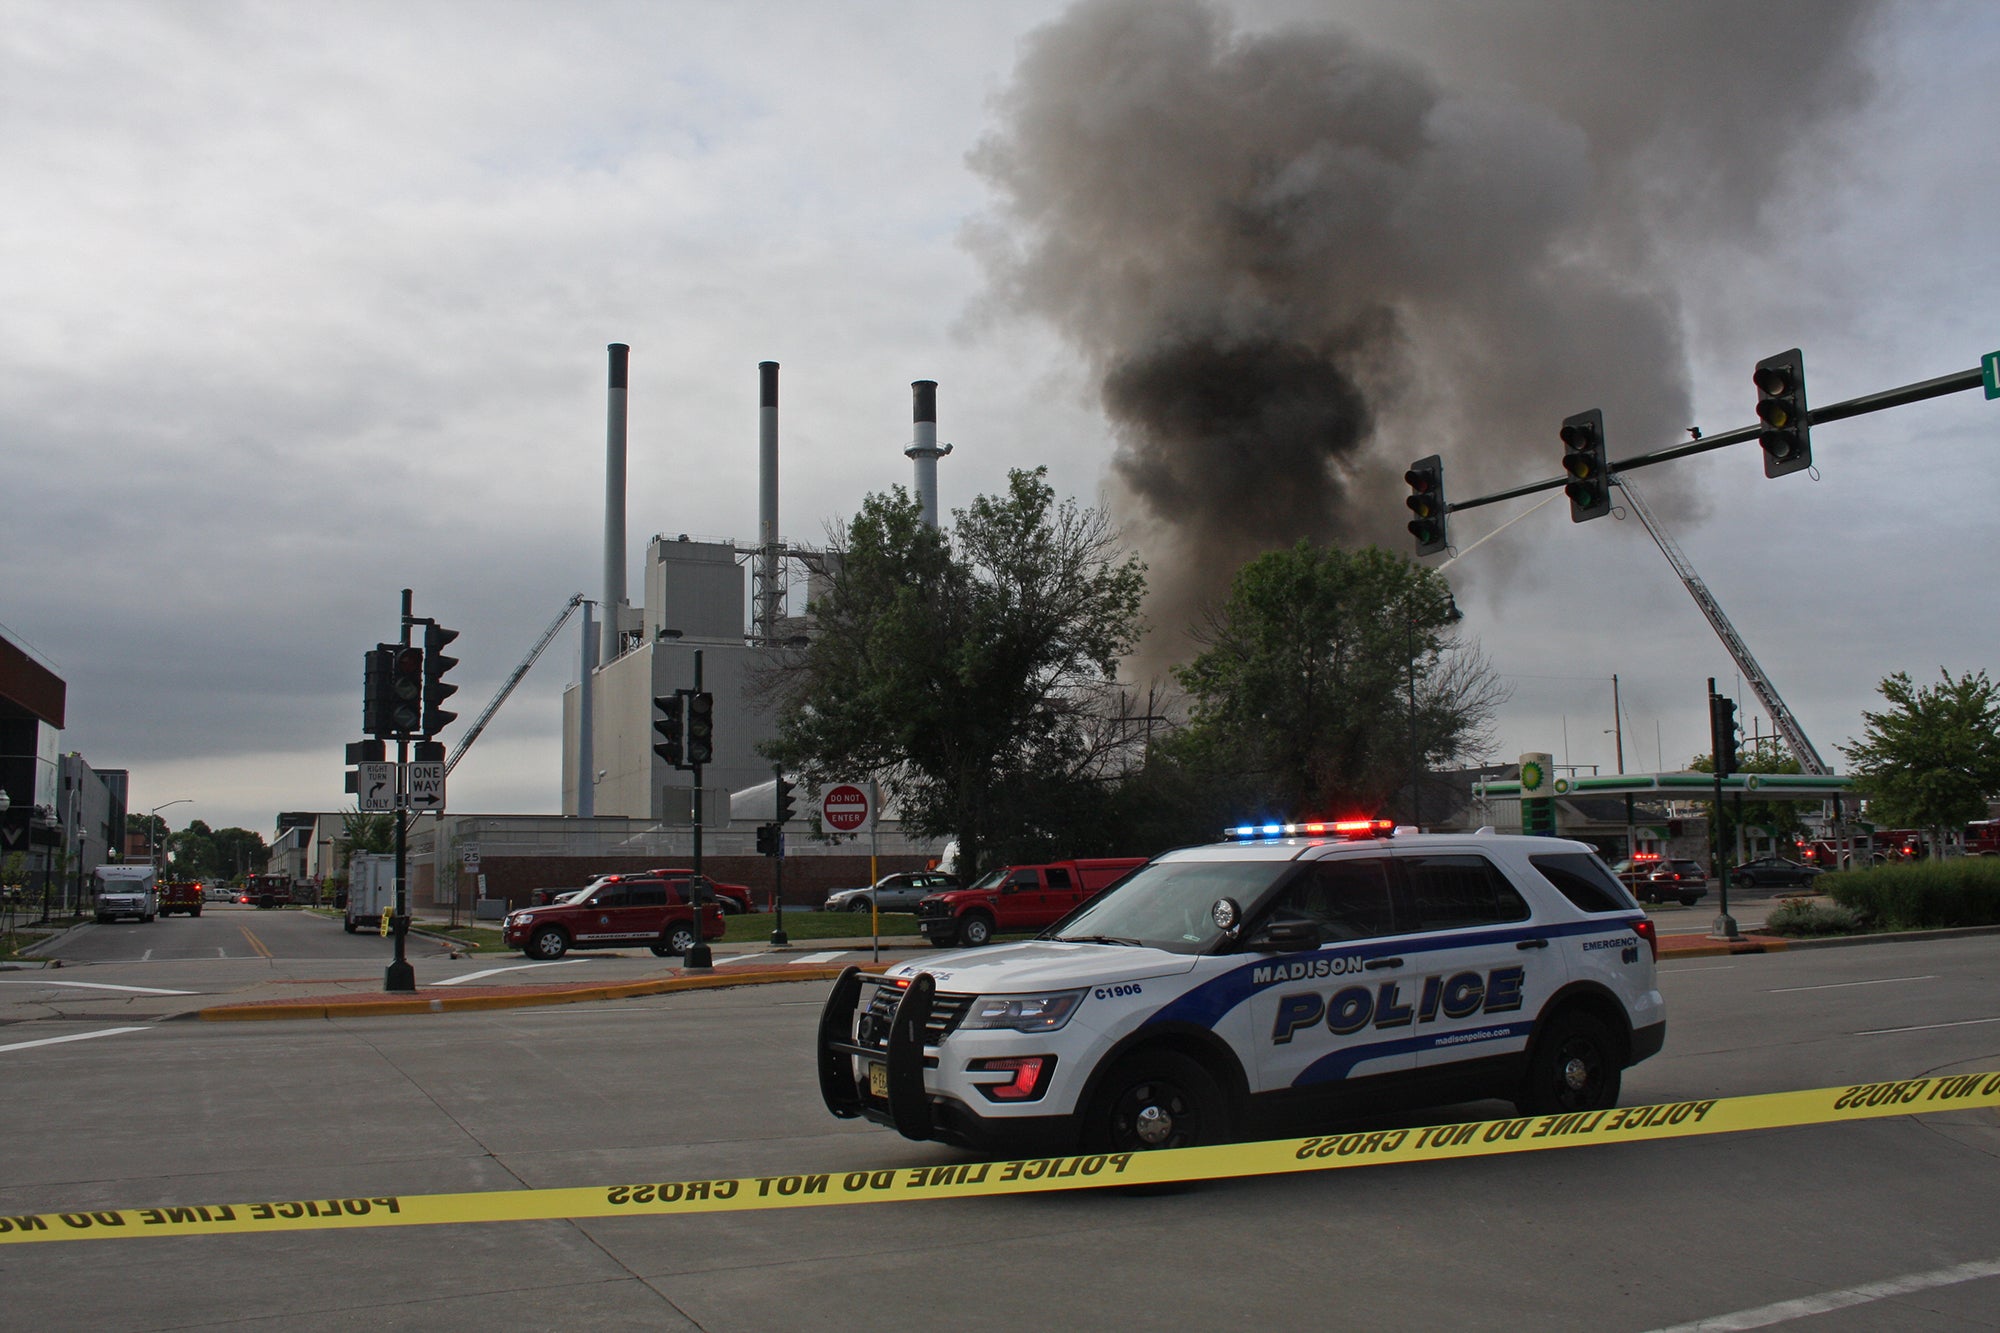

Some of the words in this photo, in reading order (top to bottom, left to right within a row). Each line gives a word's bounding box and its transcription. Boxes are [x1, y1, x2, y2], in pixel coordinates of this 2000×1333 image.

[367, 765, 388, 773] RIGHT
[413, 767, 440, 779] ONE
[413, 780, 441, 792] WAY
[366, 799, 389, 808] ONLY
[844, 794, 860, 802] NOT
[832, 814, 860, 822] ENTER
[464, 852, 479, 862] 25
[162, 884, 170, 896] 3
[1582, 936, 1639, 952] EMERGENCY
[1252, 955, 1363, 985] MADISON
[1094, 983, 1143, 1001] C1906
[1271, 964, 1526, 1046] POLICE
[1434, 1026, 1512, 1047] madisonpolice.com
